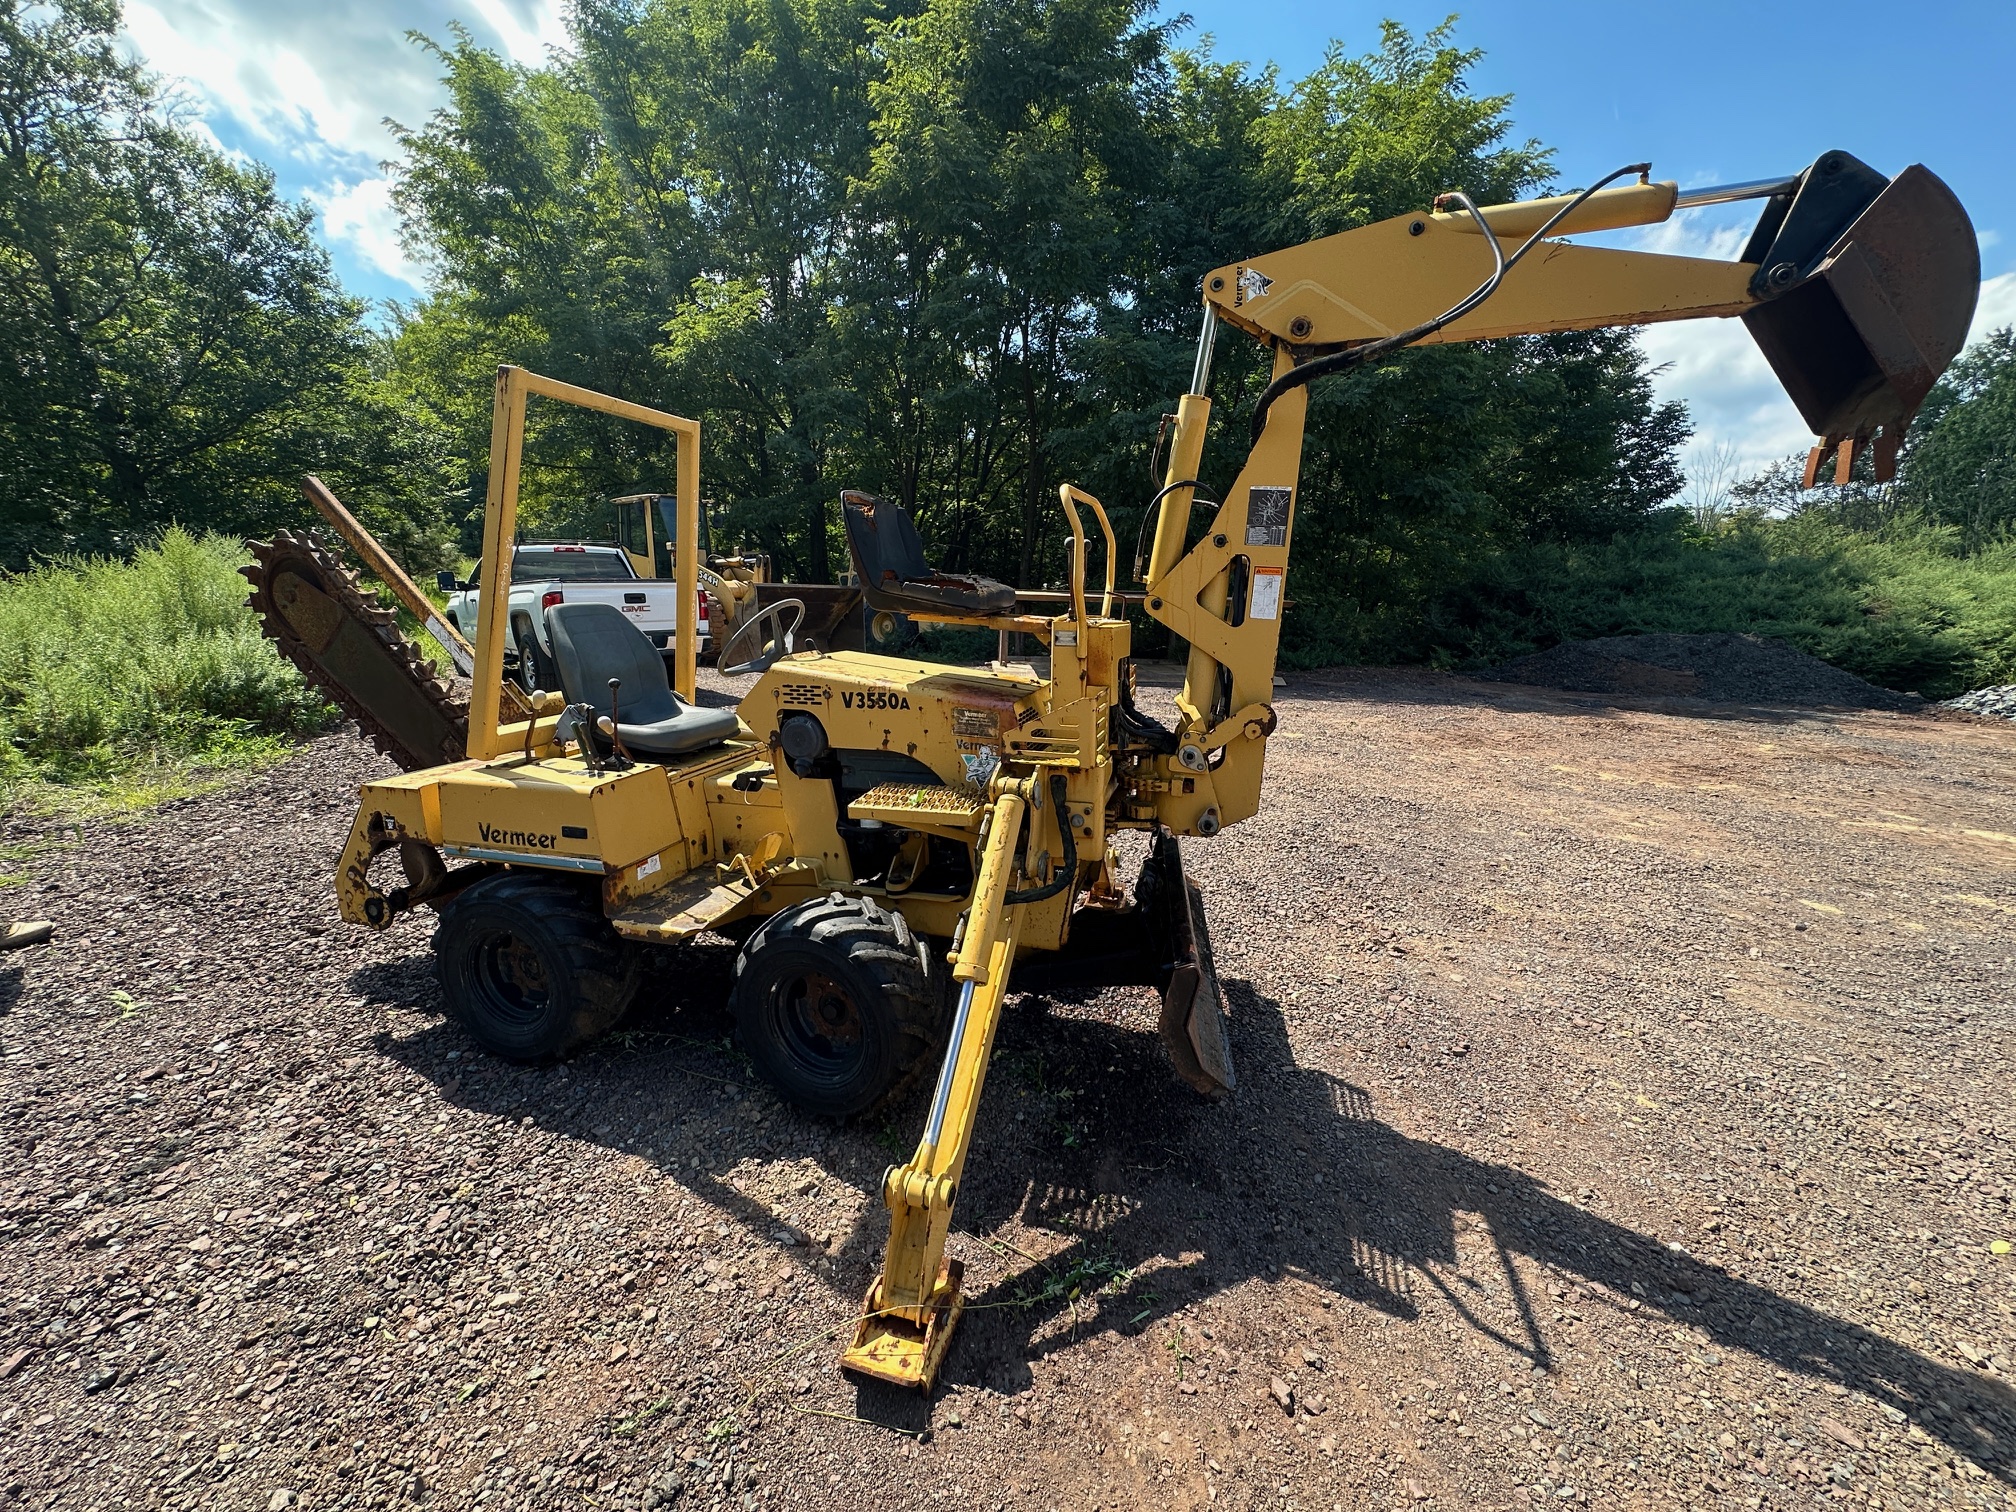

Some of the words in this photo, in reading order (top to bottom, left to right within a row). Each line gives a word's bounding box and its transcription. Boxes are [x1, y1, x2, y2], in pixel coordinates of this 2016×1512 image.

[698, 569, 719, 587] 544H
[621, 605, 651, 613] GMC
[841, 691, 911, 711] V3550A
[478, 821, 557, 849] Vermeer
